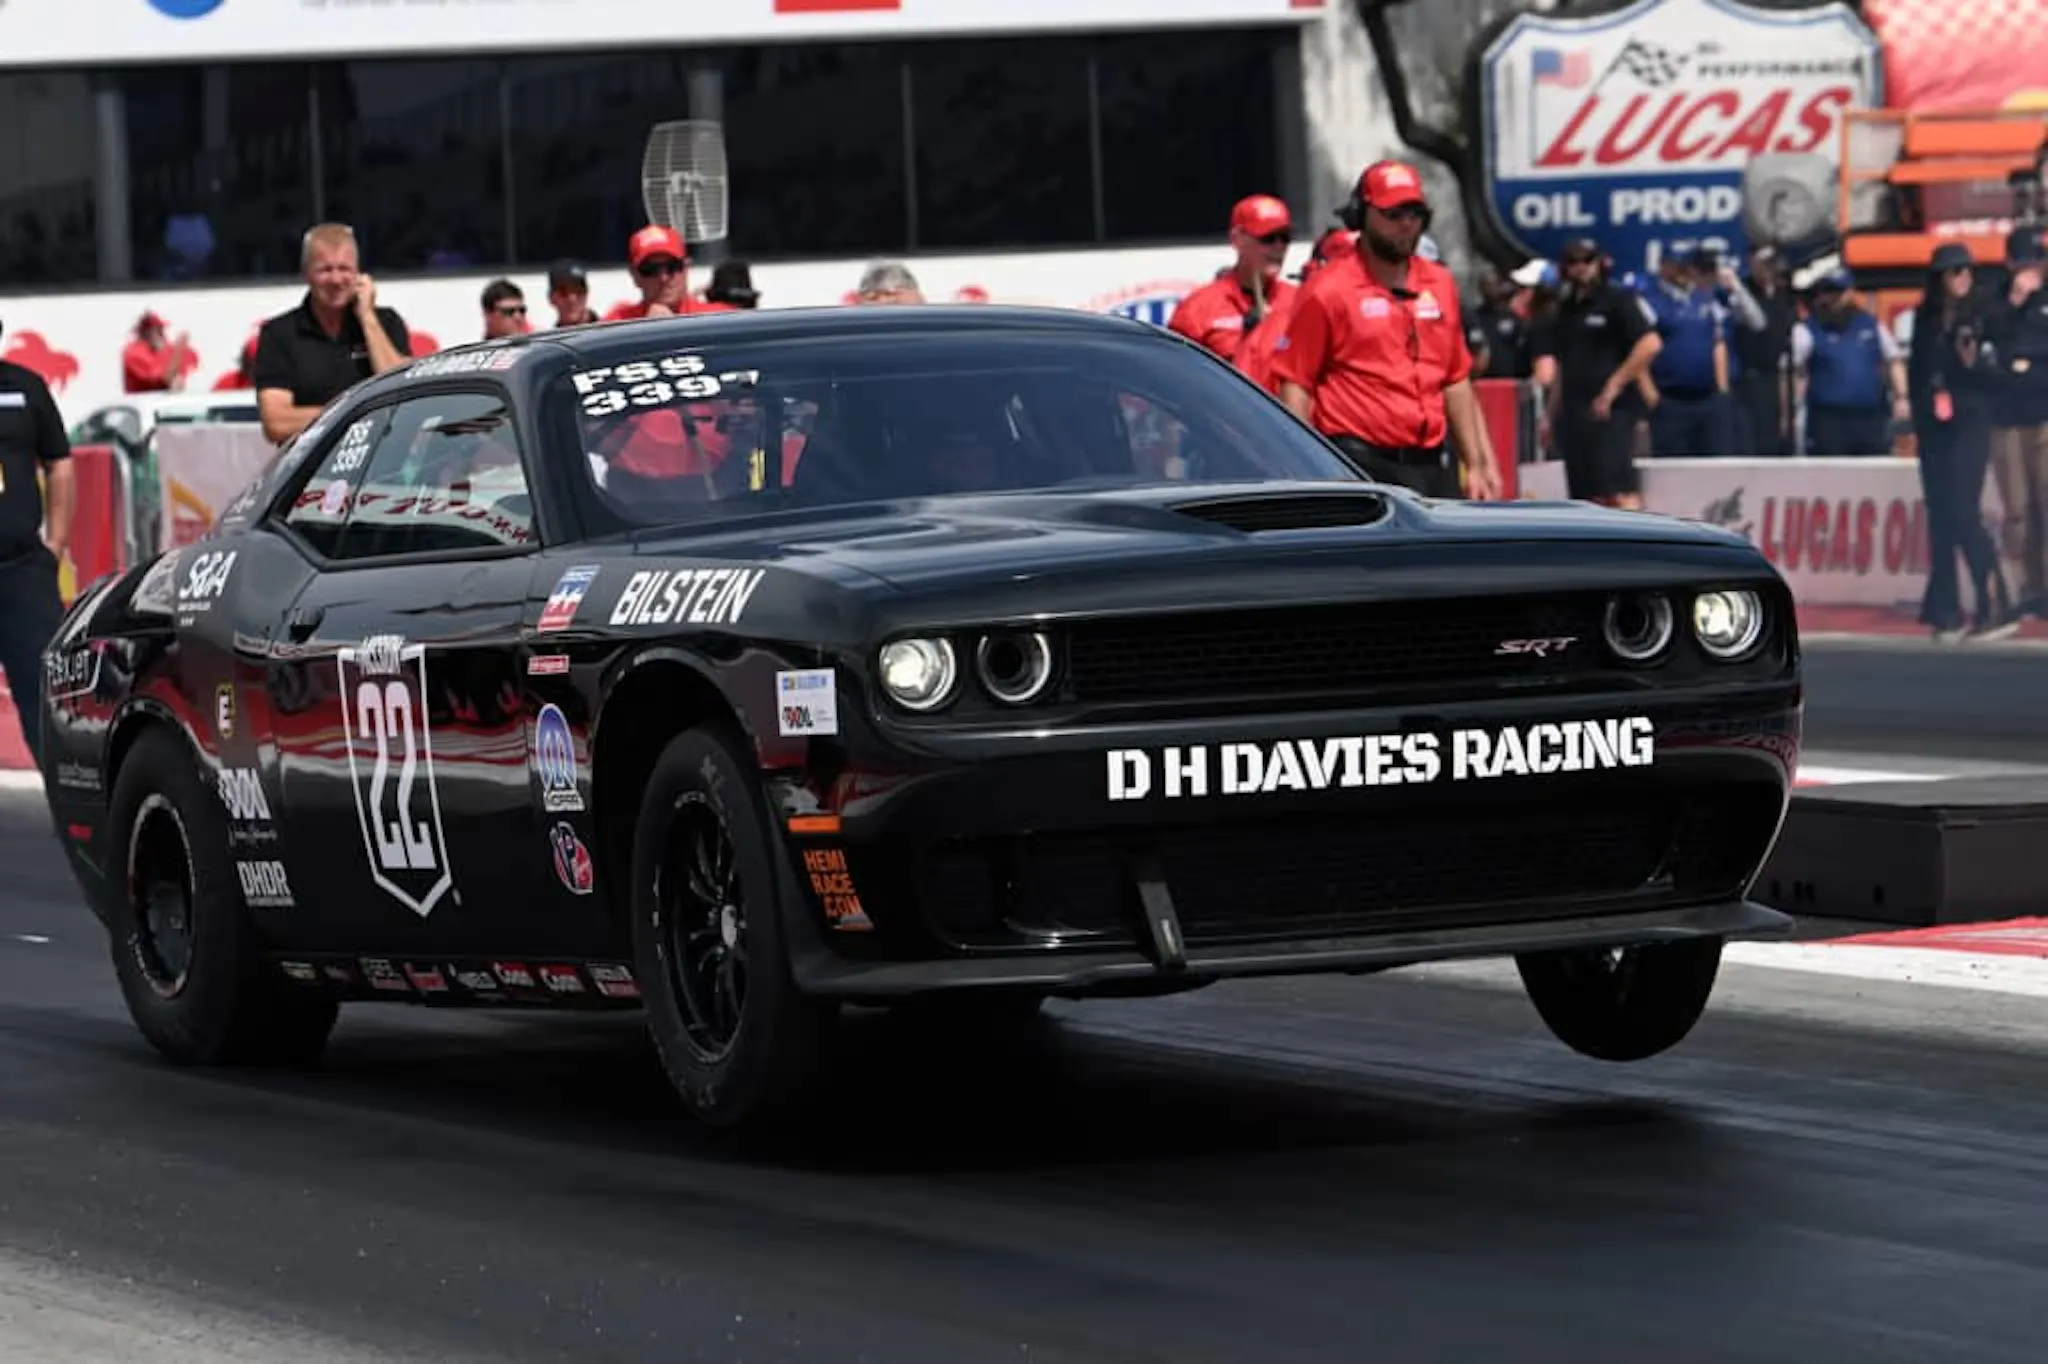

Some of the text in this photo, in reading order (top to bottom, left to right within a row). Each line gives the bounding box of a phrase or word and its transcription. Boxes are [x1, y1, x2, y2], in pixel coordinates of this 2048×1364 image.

[1535, 88, 1853, 167] LUCAS
[1513, 186, 1741, 228] OIL PROD
[573, 355, 705, 394] FSS
[582, 370, 759, 416] 3397
[1761, 496, 1878, 575] LUCAS
[609, 569, 766, 626] BILSTEIN
[1493, 637, 1578, 657] SRT
[357, 681, 436, 869] 22
[1107, 717, 1654, 799] D H DAVIES RACING
[236, 860, 291, 897] DHDR
[803, 848, 848, 872] HEMI
[810, 871, 857, 895] RACE
